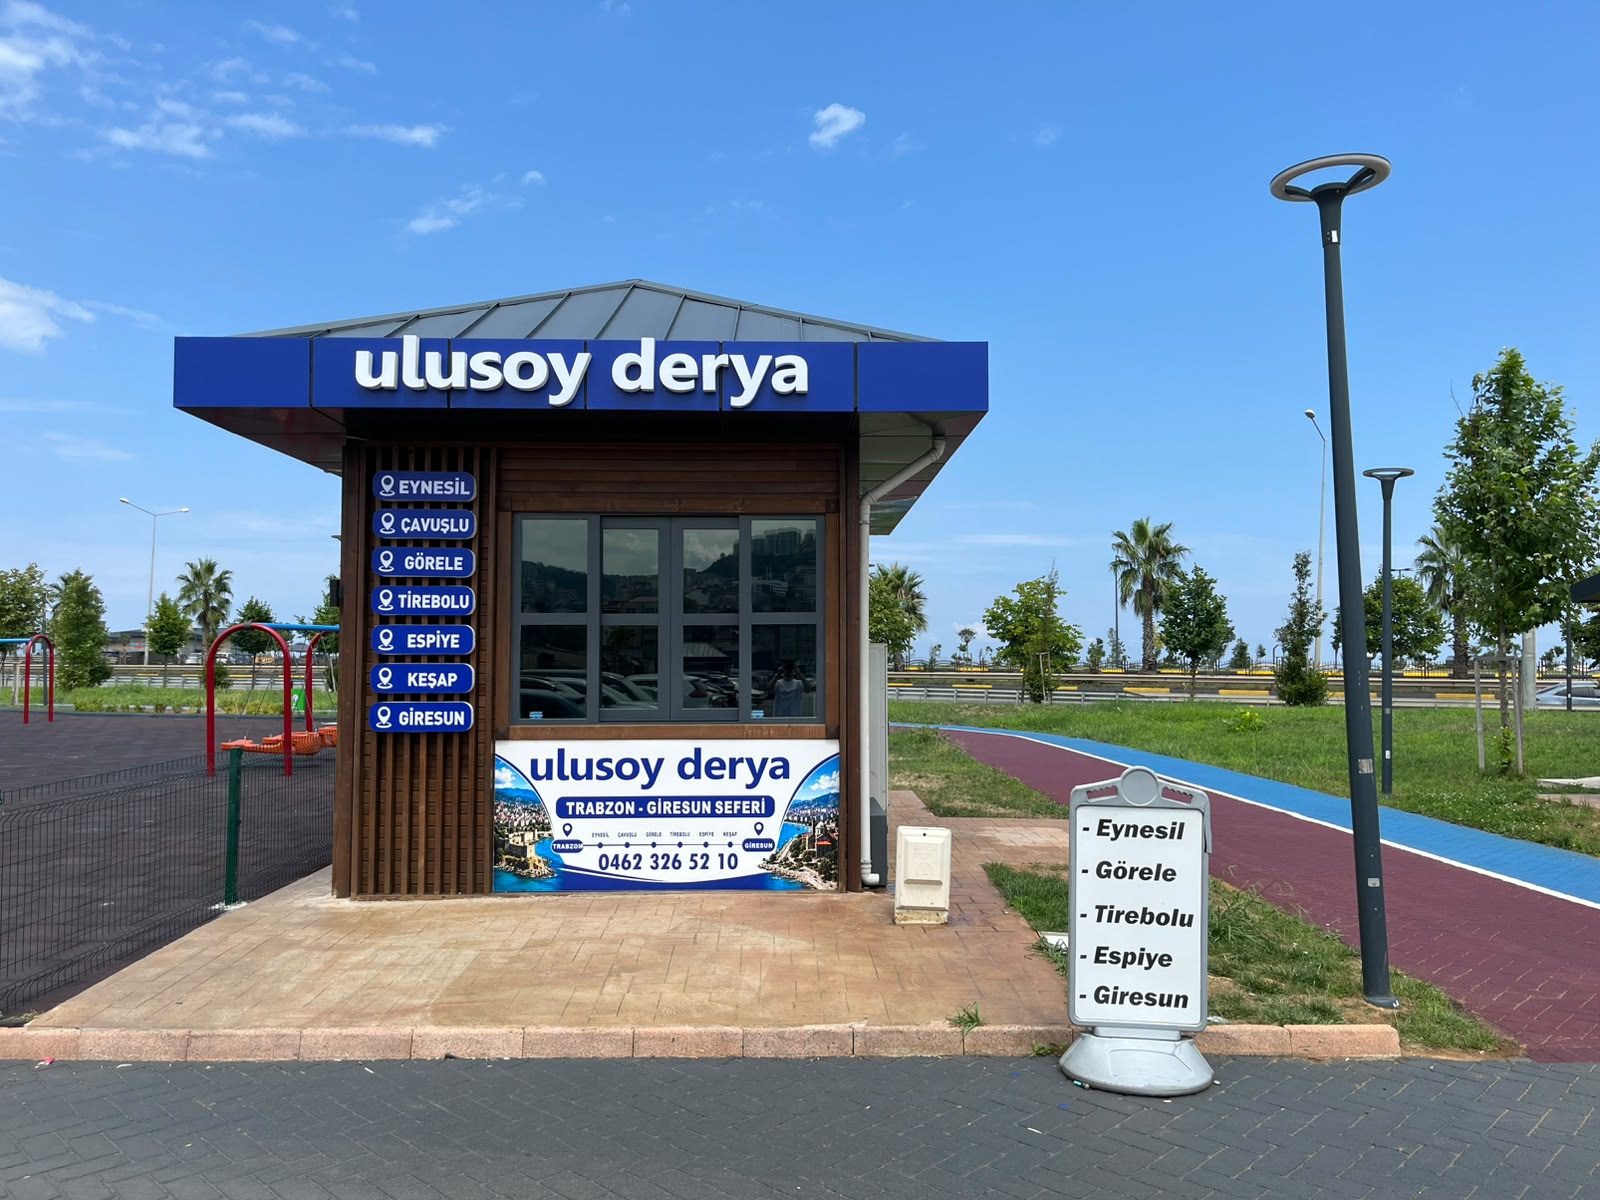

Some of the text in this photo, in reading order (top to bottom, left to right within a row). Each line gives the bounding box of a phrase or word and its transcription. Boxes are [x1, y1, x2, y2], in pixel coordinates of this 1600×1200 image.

[354, 334, 809, 409] ulusoy derya
[398, 477, 470, 496] EYNESİL
[400, 517, 469, 535] ÇAVUŞLU
[404, 552, 463, 571] GÖRELE
[398, 590, 469, 609] TİREBOLU
[407, 630, 460, 649] ESPİYE
[407, 672, 457, 688] KEŞAP
[398, 707, 465, 726] GİRESUN
[530, 747, 790, 790] ulusoy derya
[566, 801, 636, 815] TRABZON
[646, 798, 712, 815] GİRESUN
[715, 797, 766, 815] SEFERİ
[1096, 818, 1185, 841] Eynesil
[598, 853, 739, 870] 0462 326 52 10
[1095, 860, 1177, 882] Görele
[1094, 904, 1194, 928] Tirebolu
[1093, 946, 1173, 970] Espiye
[1093, 985, 1189, 1009] Giresun
